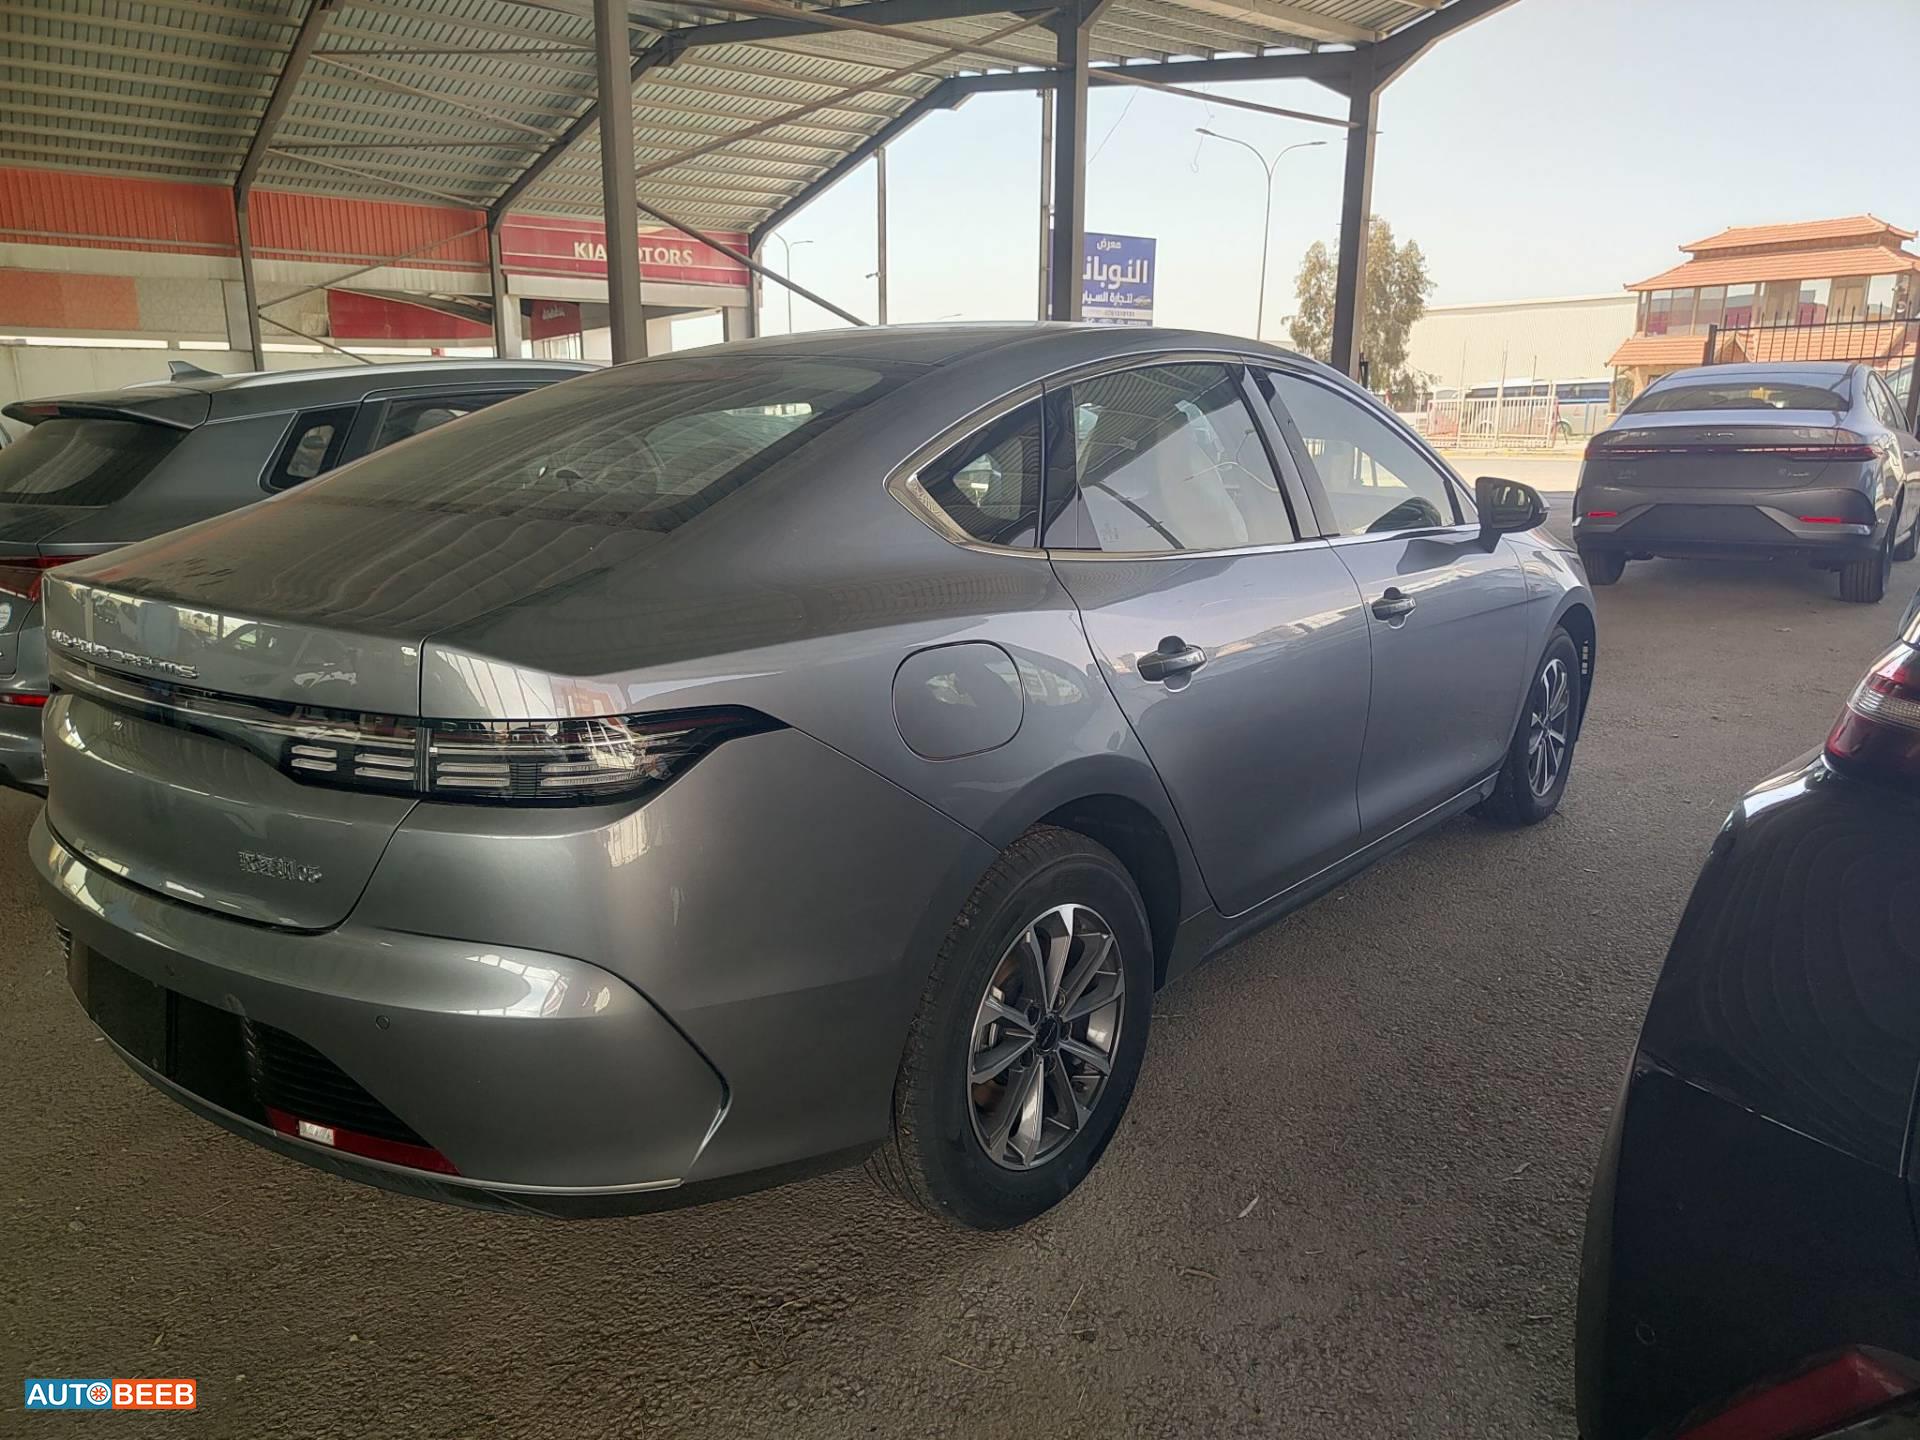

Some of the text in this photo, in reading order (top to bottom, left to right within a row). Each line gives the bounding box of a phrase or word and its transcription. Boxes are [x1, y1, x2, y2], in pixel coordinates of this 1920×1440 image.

[573, 241, 693, 266] KIA TORS
[1096, 238, 1121, 251] معرض
[1082, 255, 1148, 289] النوبان
